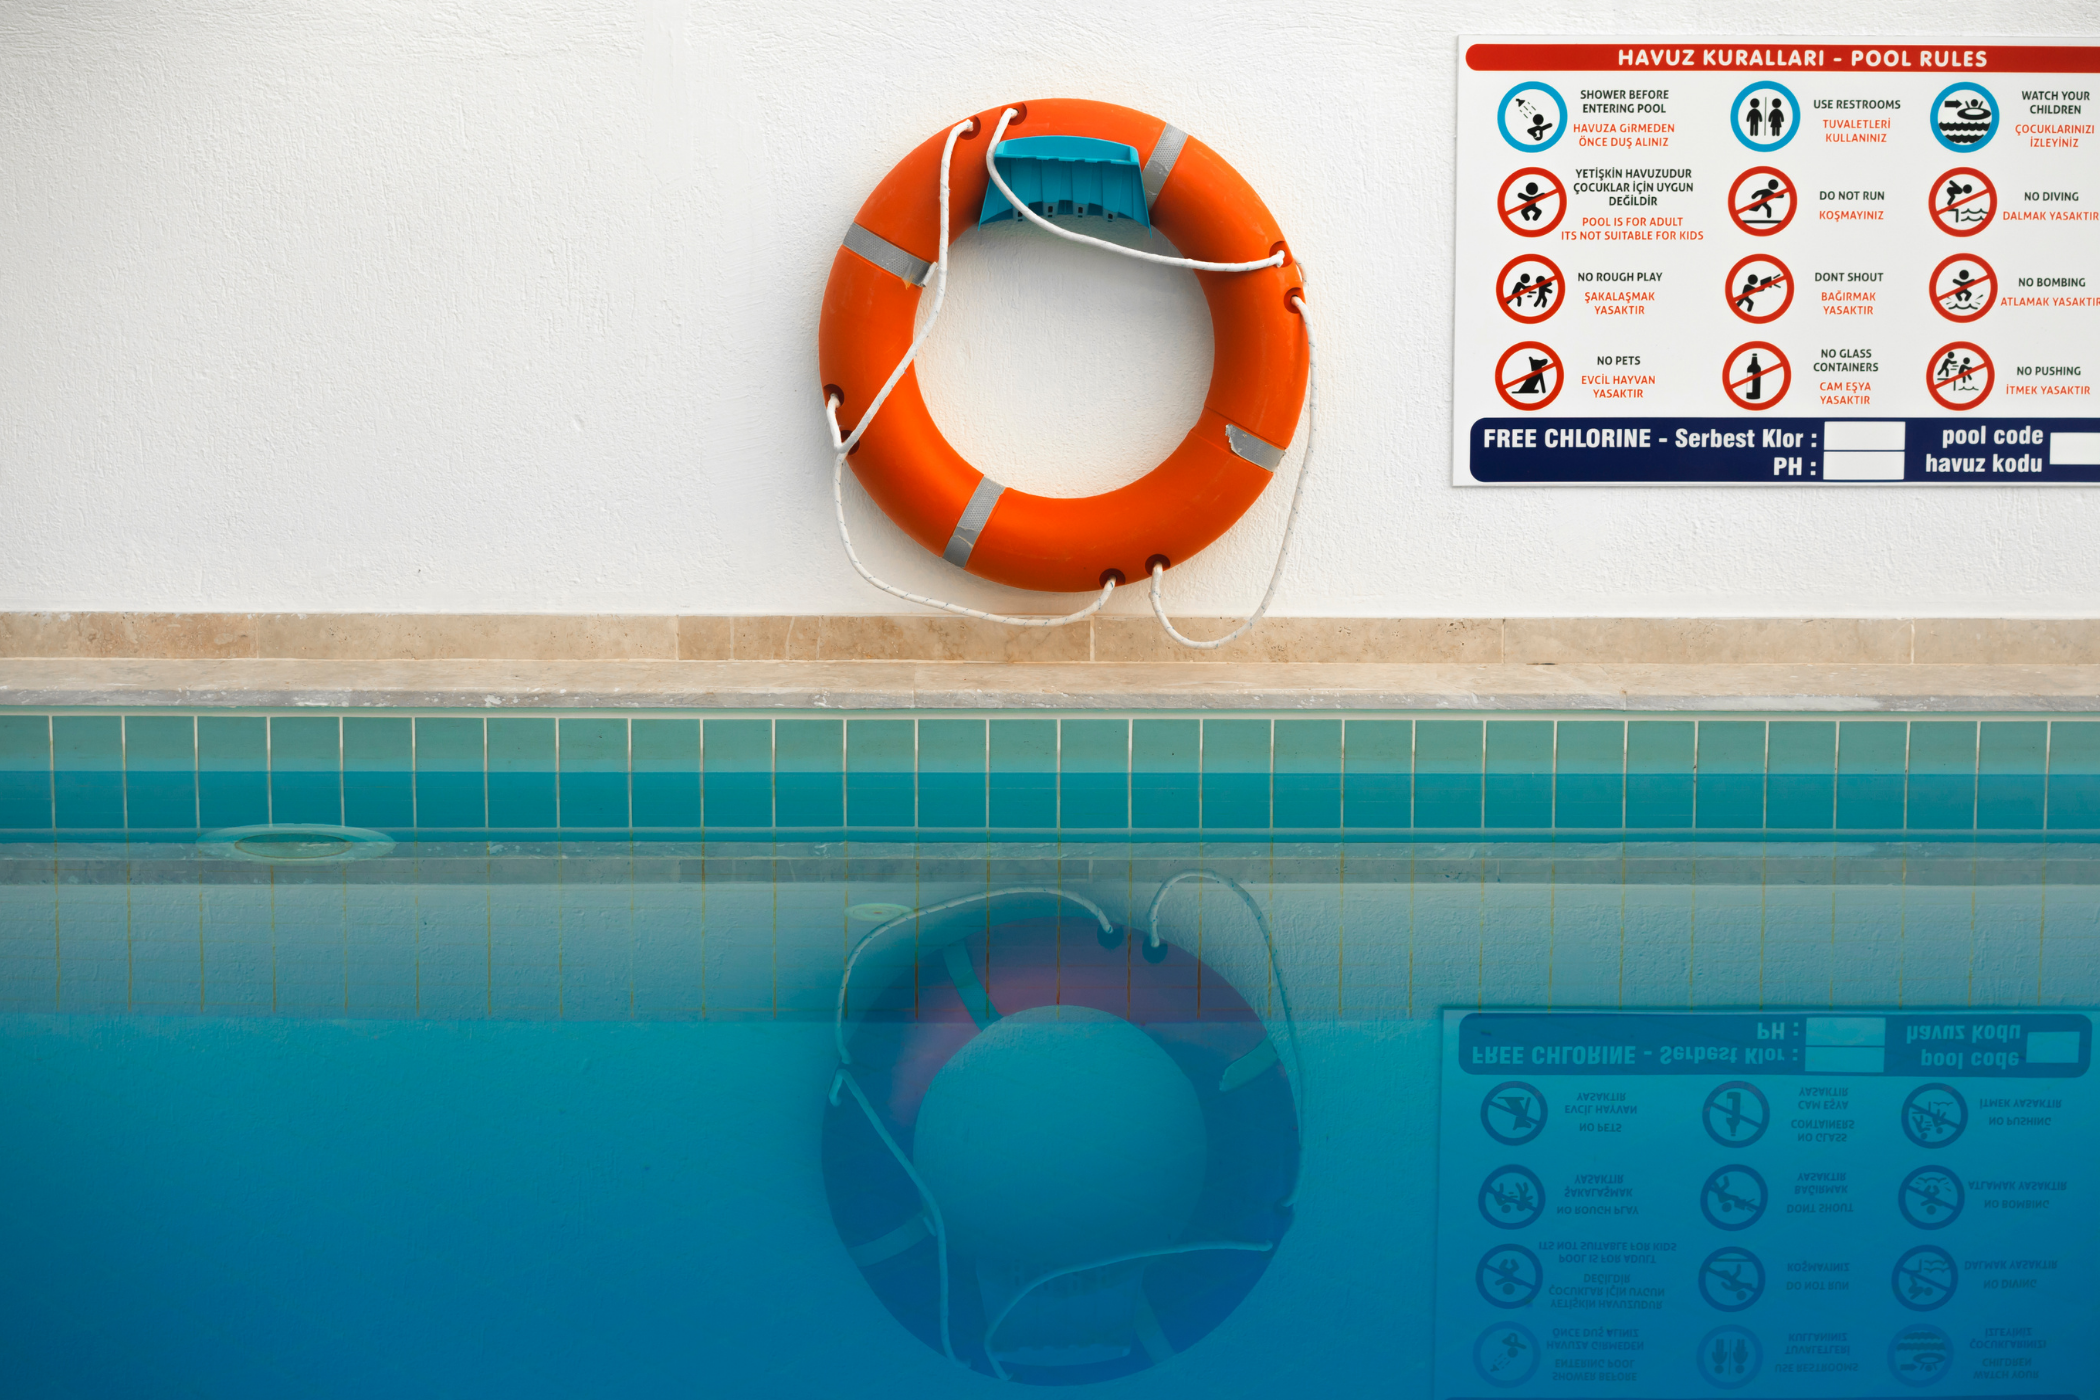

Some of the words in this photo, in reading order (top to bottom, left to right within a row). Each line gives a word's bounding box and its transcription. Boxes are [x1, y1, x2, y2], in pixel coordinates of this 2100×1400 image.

[1618, 49, 1695, 66] HAVUZ
[1703, 49, 1824, 66] KURALLARI
[1851, 50, 1911, 67] POOL
[1920, 50, 1987, 67] RULES
[1580, 89, 1626, 100] SHOWER
[1629, 89, 1669, 100] BEFORE
[2021, 91, 2059, 101] WATCH
[2061, 91, 2090, 101] YOUR
[1583, 103, 1635, 113] ENTERING
[1637, 103, 1666, 113] POOL
[1813, 99, 1833, 109] USE
[1836, 99, 1901, 109] RESTROOMS
[2029, 104, 2081, 115] CHILDREN
[1573, 123, 1617, 133] HAVUZA
[1823, 118, 1891, 129] TUVALETLERİ
[2015, 124, 2095, 136] ÇOCUKLARINIZI
[1578, 135, 1607, 147] ÖNCE
[1610, 137, 1632, 149] DUŞ
[1635, 137, 1669, 147] ALINIZ
[1825, 133, 1887, 143] KULLANINIZ
[2030, 136, 2079, 148] İZLEYİNİZ
[1575, 167, 1623, 181] YETİŞKİN
[1625, 169, 1692, 179] HAVUZUDUR
[1573, 182, 1630, 195] ÇOCUKLAR
[1631, 181, 1654, 195] İÇİN
[1656, 182, 1693, 192] UYGUN
[1609, 194, 1657, 206] DEĞİLDİR
[1819, 191, 1836, 200] DO
[1838, 191, 1860, 200] NOT
[1863, 191, 1885, 201] RUN
[2024, 191, 2040, 201] NO
[2042, 191, 2079, 202] DIVING
[1819, 210, 1884, 222] KOŞMAYINIZ
[2003, 211, 2046, 221] DALMAK
[2049, 211, 2099, 221] YASAKTIR
[1582, 217, 1611, 227] POOL
[1614, 217, 1623, 227] IS
[1626, 217, 1647, 227] FOR
[1649, 217, 1683, 227] ADULT
[1561, 231, 1577, 241] ITS
[1580, 231, 1601, 240] NOT
[1604, 231, 1653, 241] SUITABLE
[1656, 230, 1676, 240] FOR
[1679, 230, 1704, 240] KIDS
[1578, 272, 1594, 282] NO
[1596, 272, 1634, 282] ROUGH
[1637, 272, 1663, 282] PLAY
[1815, 272, 1845, 282] DONT
[1847, 272, 1884, 282] SHOUT
[2018, 277, 2034, 287] NO
[2037, 277, 2086, 287] BOMBING
[1585, 291, 1655, 304] ŞAKALAŞMAK
[1821, 290, 1876, 301] BAĞIRMAK
[2000, 297, 2049, 306] ATLAMAK
[1594, 305, 1645, 315] YASAKTIR
[1823, 305, 1873, 315] YASAKTIR
[1821, 349, 1837, 358] NO
[1839, 349, 1872, 358] GLASS
[1597, 356, 1613, 366] NO
[1615, 356, 1641, 365] PETS
[1813, 362, 1879, 372] CONTAINERS
[2017, 366, 2032, 376] NO
[2035, 366, 2081, 376] PUSHING
[1581, 374, 1610, 385] EVCİL
[1613, 375, 1655, 384] HAYVAN
[1593, 389, 1643, 398] YASAKTIR
[1819, 382, 1843, 391] CAM
[1846, 382, 1871, 394] EŞYA
[2006, 384, 2037, 395] İTMEK
[2040, 385, 2090, 395] YASAKTIR
[1820, 395, 1870, 405] YASAKTIR
[1484, 429, 1537, 448] FREE
[1545, 428, 1651, 448] CHLORINE
[1675, 428, 1755, 448] Serbest
[1762, 429, 1804, 448] Klor
[1942, 425, 1986, 448] pool
[1994, 425, 2043, 445] code
[1774, 457, 1802, 476] PH
[1926, 453, 1986, 472] havuz
[1992, 453, 2042, 473] kodu
